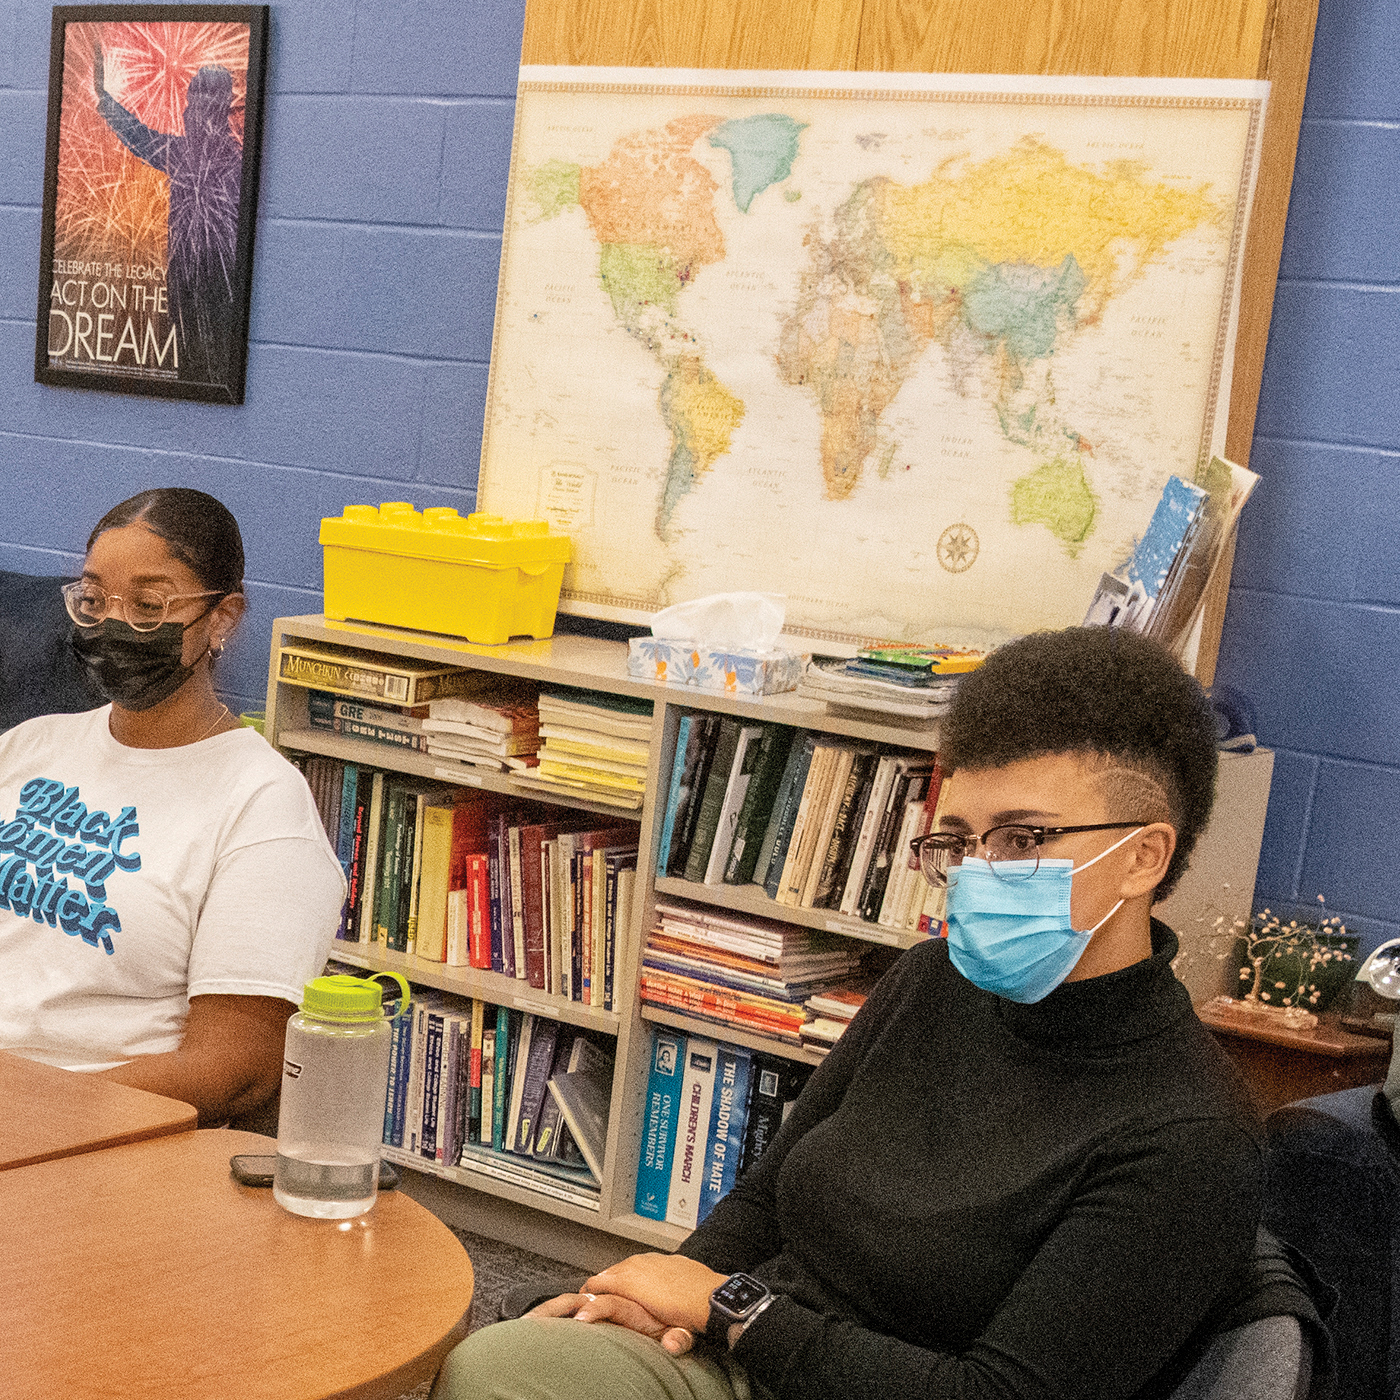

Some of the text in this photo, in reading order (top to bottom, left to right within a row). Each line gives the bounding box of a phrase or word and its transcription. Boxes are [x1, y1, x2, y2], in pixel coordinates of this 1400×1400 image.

[53, 259, 167, 281] CELEBRATE THE LEGACY
[51, 280, 168, 313] ACT ON THE
[48, 310, 178, 368] DREAM
[286, 655, 341, 681] MUNCHKIN
[340, 703, 364, 720] GRE
[16, 777, 142, 873] Black
[408, 917, 416, 941] USED
[389, 1044, 398, 1073] POWER
[388, 1075, 395, 1086] TO
[644, 1092, 661, 1167] REMEMBERS
[654, 1094, 671, 1170] ONE SURVIVOR
[681, 1083, 701, 1183] CHILDREN'S MARCH
[709, 1062, 736, 1193] THE SHADOW OF HATE
[750, 1114, 770, 1157] Mighty
